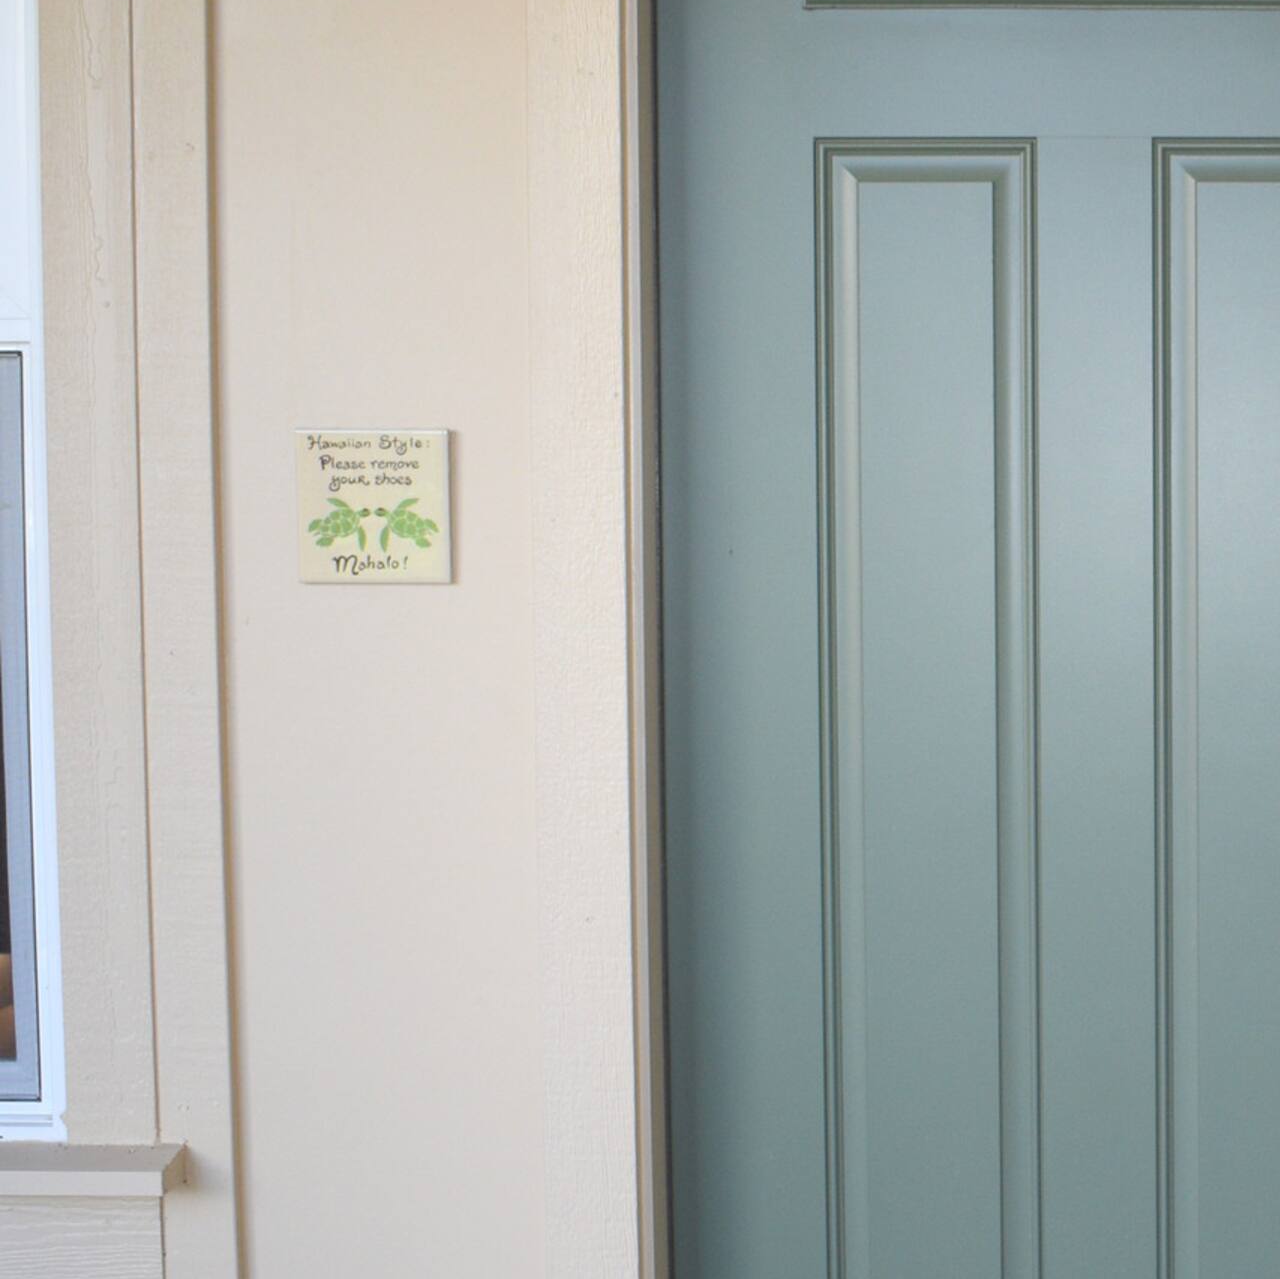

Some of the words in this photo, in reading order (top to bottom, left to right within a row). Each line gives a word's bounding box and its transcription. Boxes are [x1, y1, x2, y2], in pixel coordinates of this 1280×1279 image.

[307, 434, 371, 450] Hawaiian
[379, 434, 430, 455] Style:
[320, 454, 366, 470] Please
[371, 460, 420, 470] remove
[375, 473, 412, 485] shoes
[332, 554, 408, 575] Mahalo!
